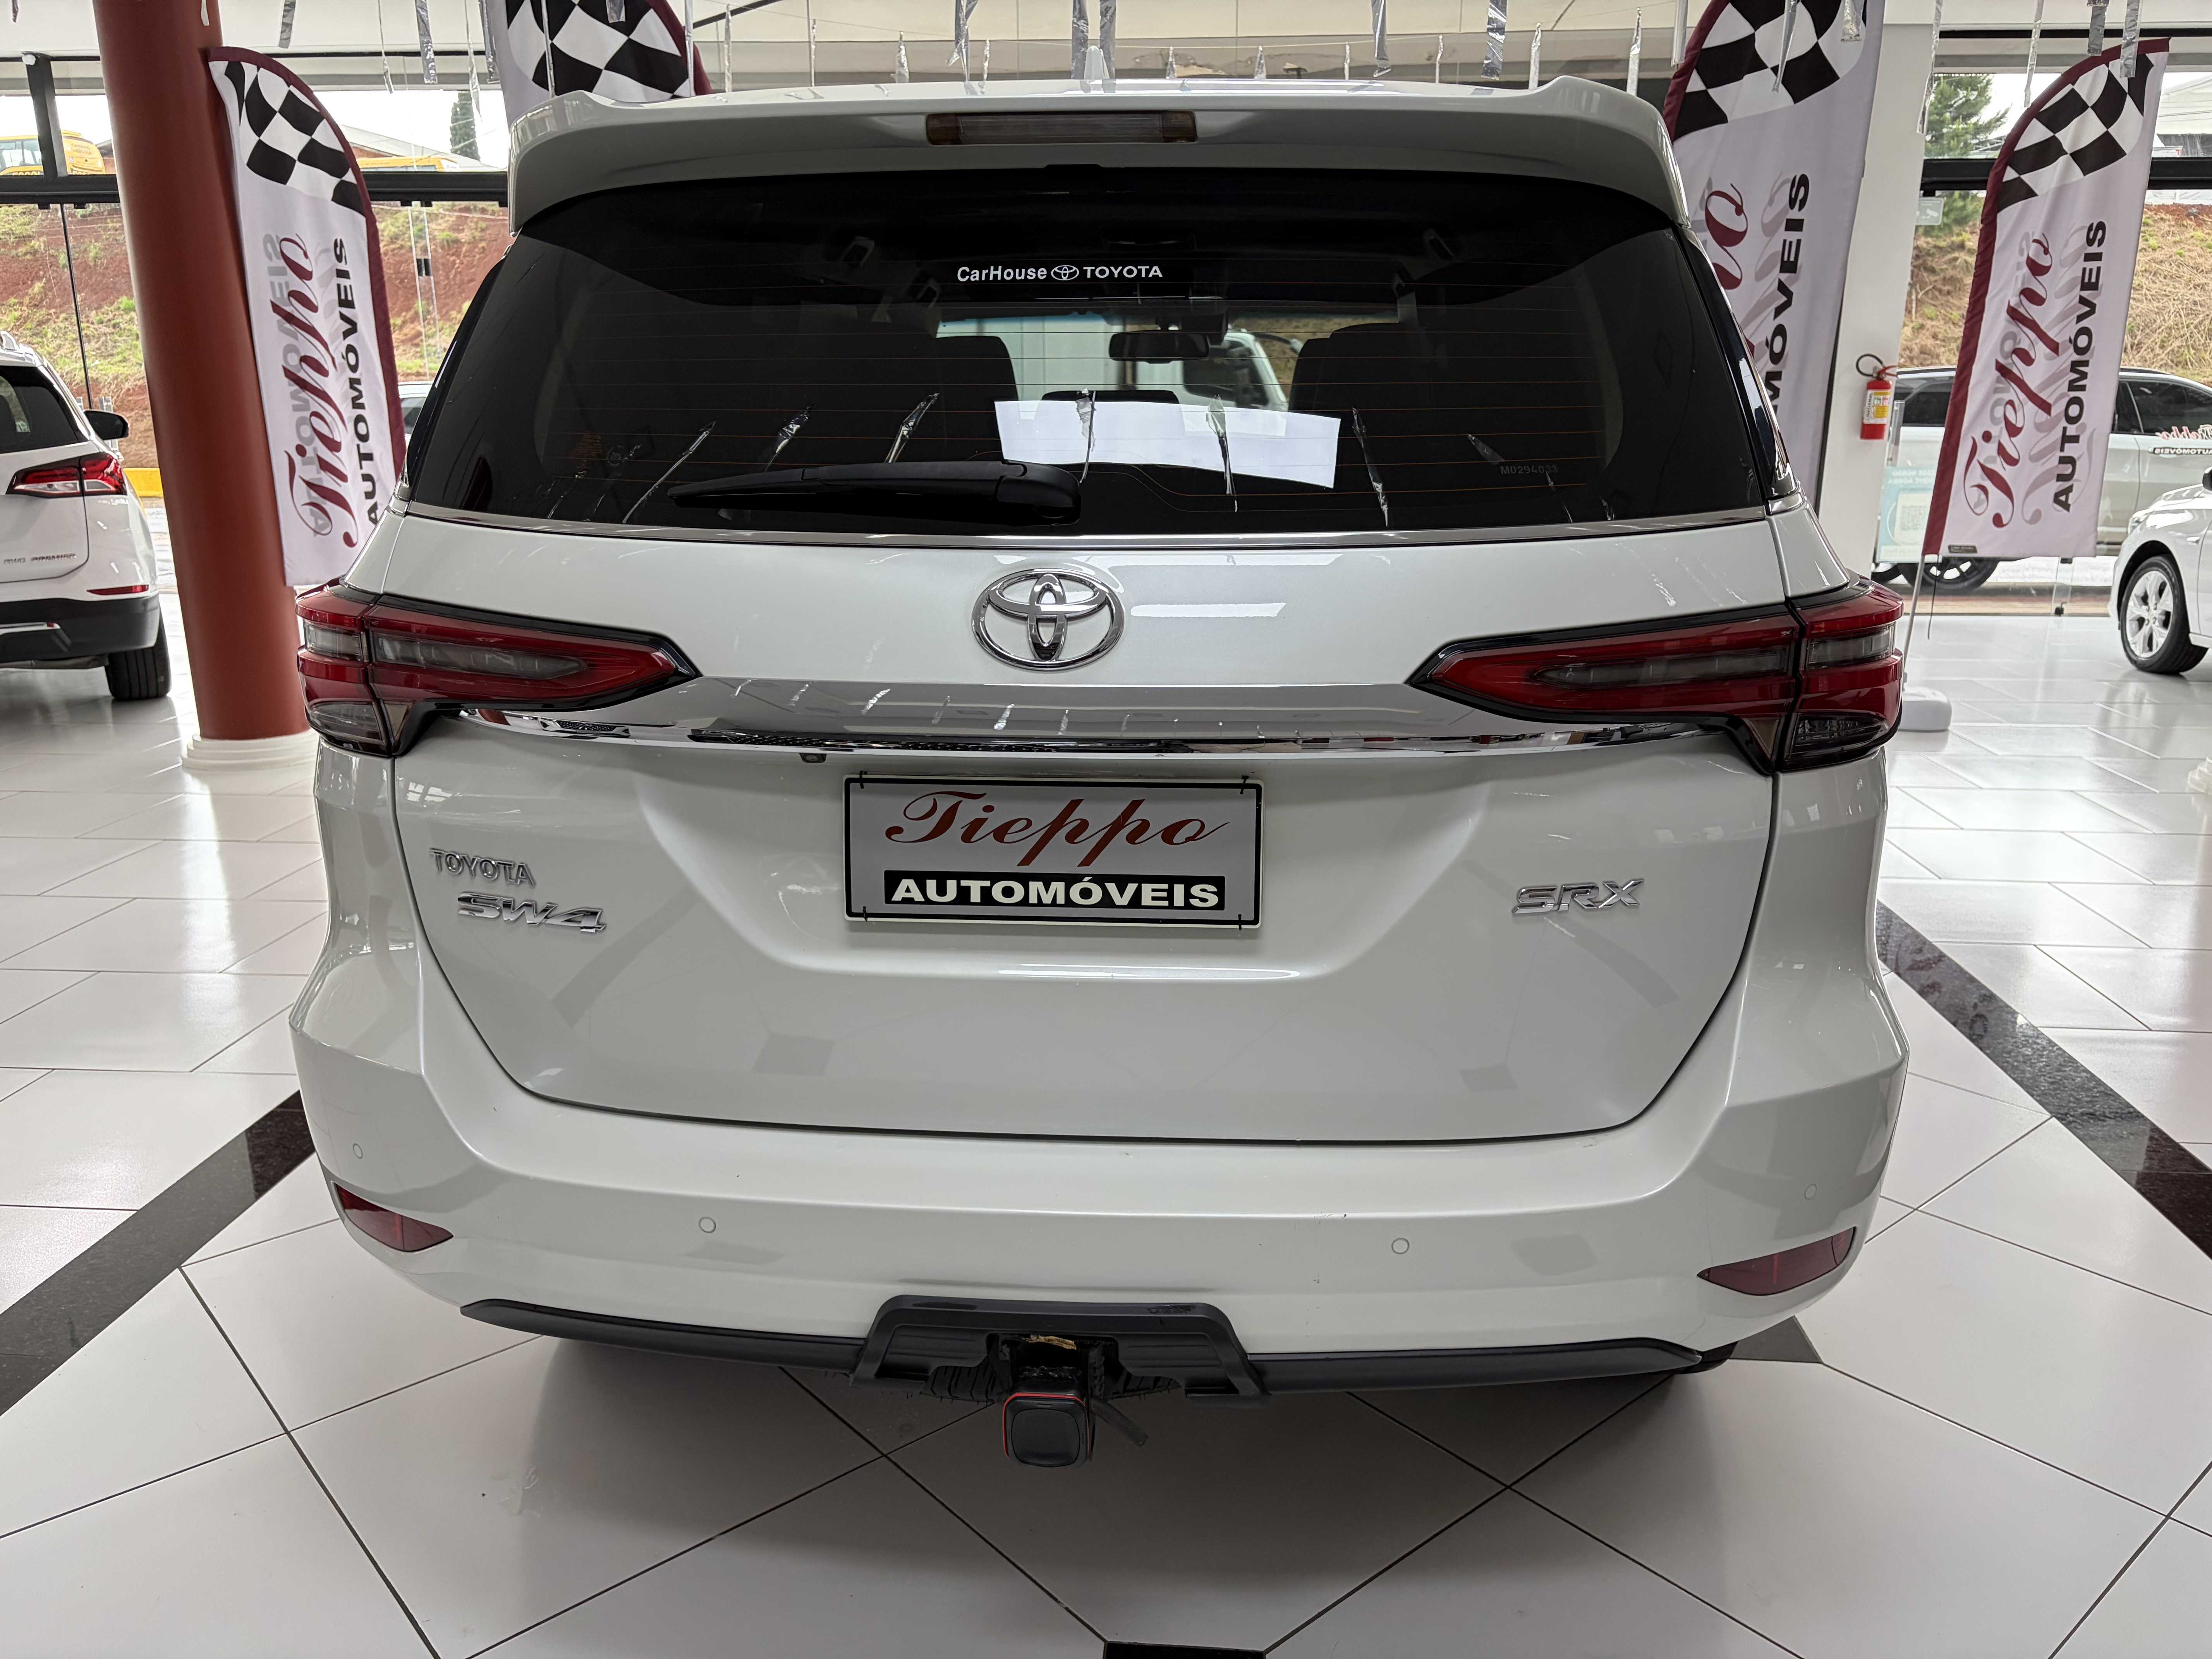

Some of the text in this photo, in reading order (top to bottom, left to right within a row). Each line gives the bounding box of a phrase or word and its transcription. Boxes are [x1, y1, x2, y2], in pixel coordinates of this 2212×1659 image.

[957, 266, 1163, 282] CarHouse TOYOTA
[1765, 173, 1810, 415] MÓVEIS
[270, 233, 358, 548] Tieppo
[334, 238, 379, 527] AUTOMÓVEIS
[1964, 233, 2059, 528] Tieppo
[2053, 221, 2107, 513] AUTOMÓVEIS
[429, 847, 537, 887] TOYOTA
[885, 790, 1230, 867] Tieppo
[457, 891, 607, 933] SW4
[891, 877, 1219, 908] AUTOMÓVEIS
[1511, 878, 1645, 914] SRX
